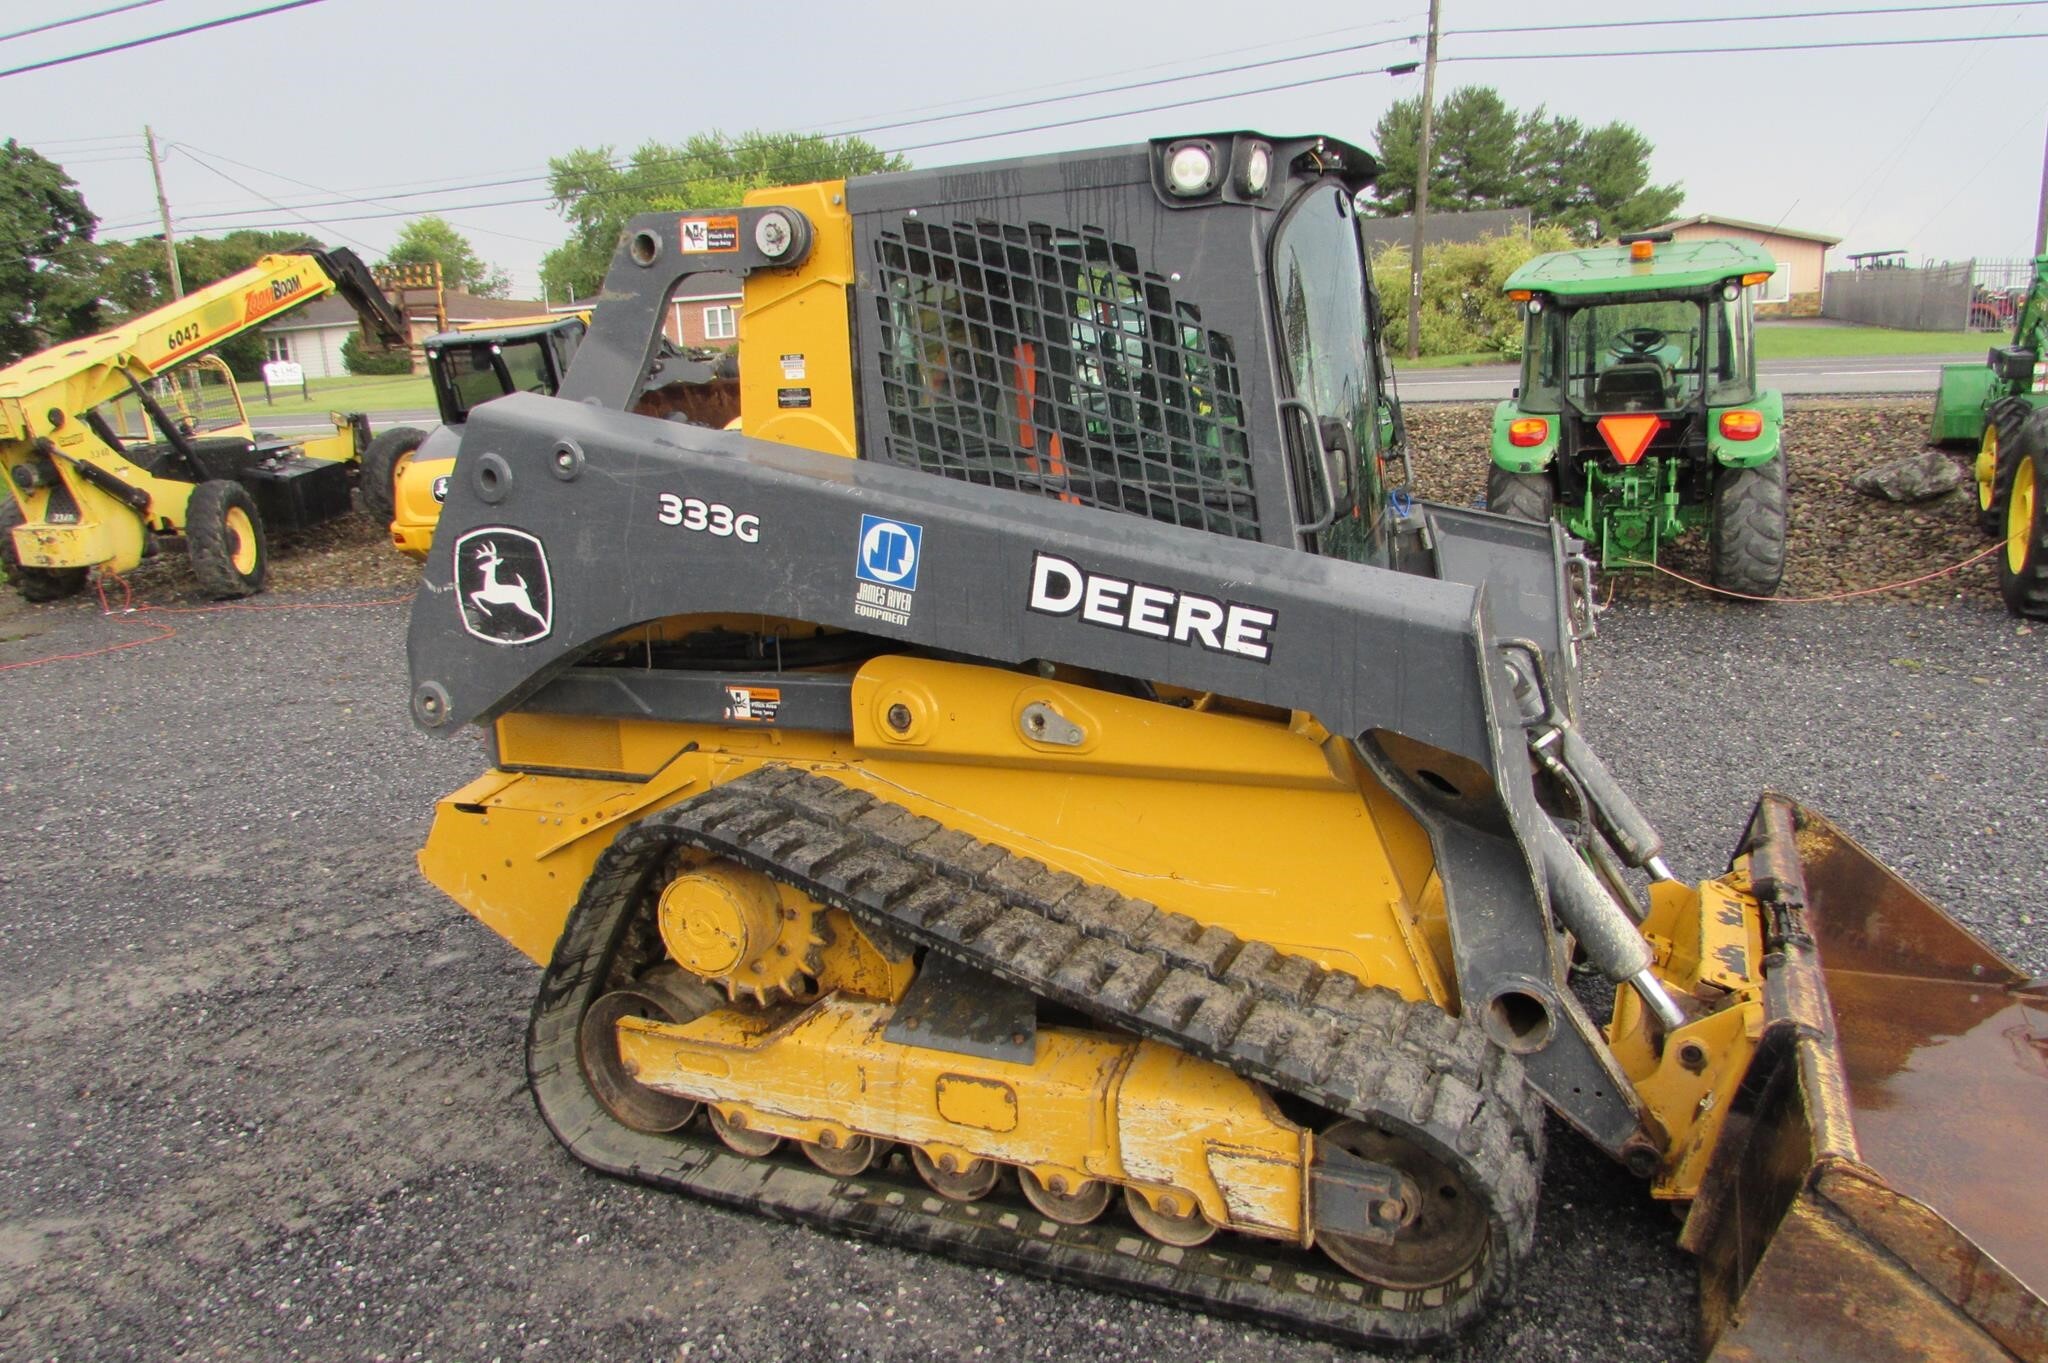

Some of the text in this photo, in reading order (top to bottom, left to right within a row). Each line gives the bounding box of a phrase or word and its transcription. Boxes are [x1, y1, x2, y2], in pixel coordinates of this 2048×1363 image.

[168, 322, 200, 350] 6042
[658, 493, 760, 543] 333G
[856, 582, 912, 612] JAMES RIVER
[1030, 555, 1273, 658] DEERE
[854, 604, 910, 627] EQUIPMENT
